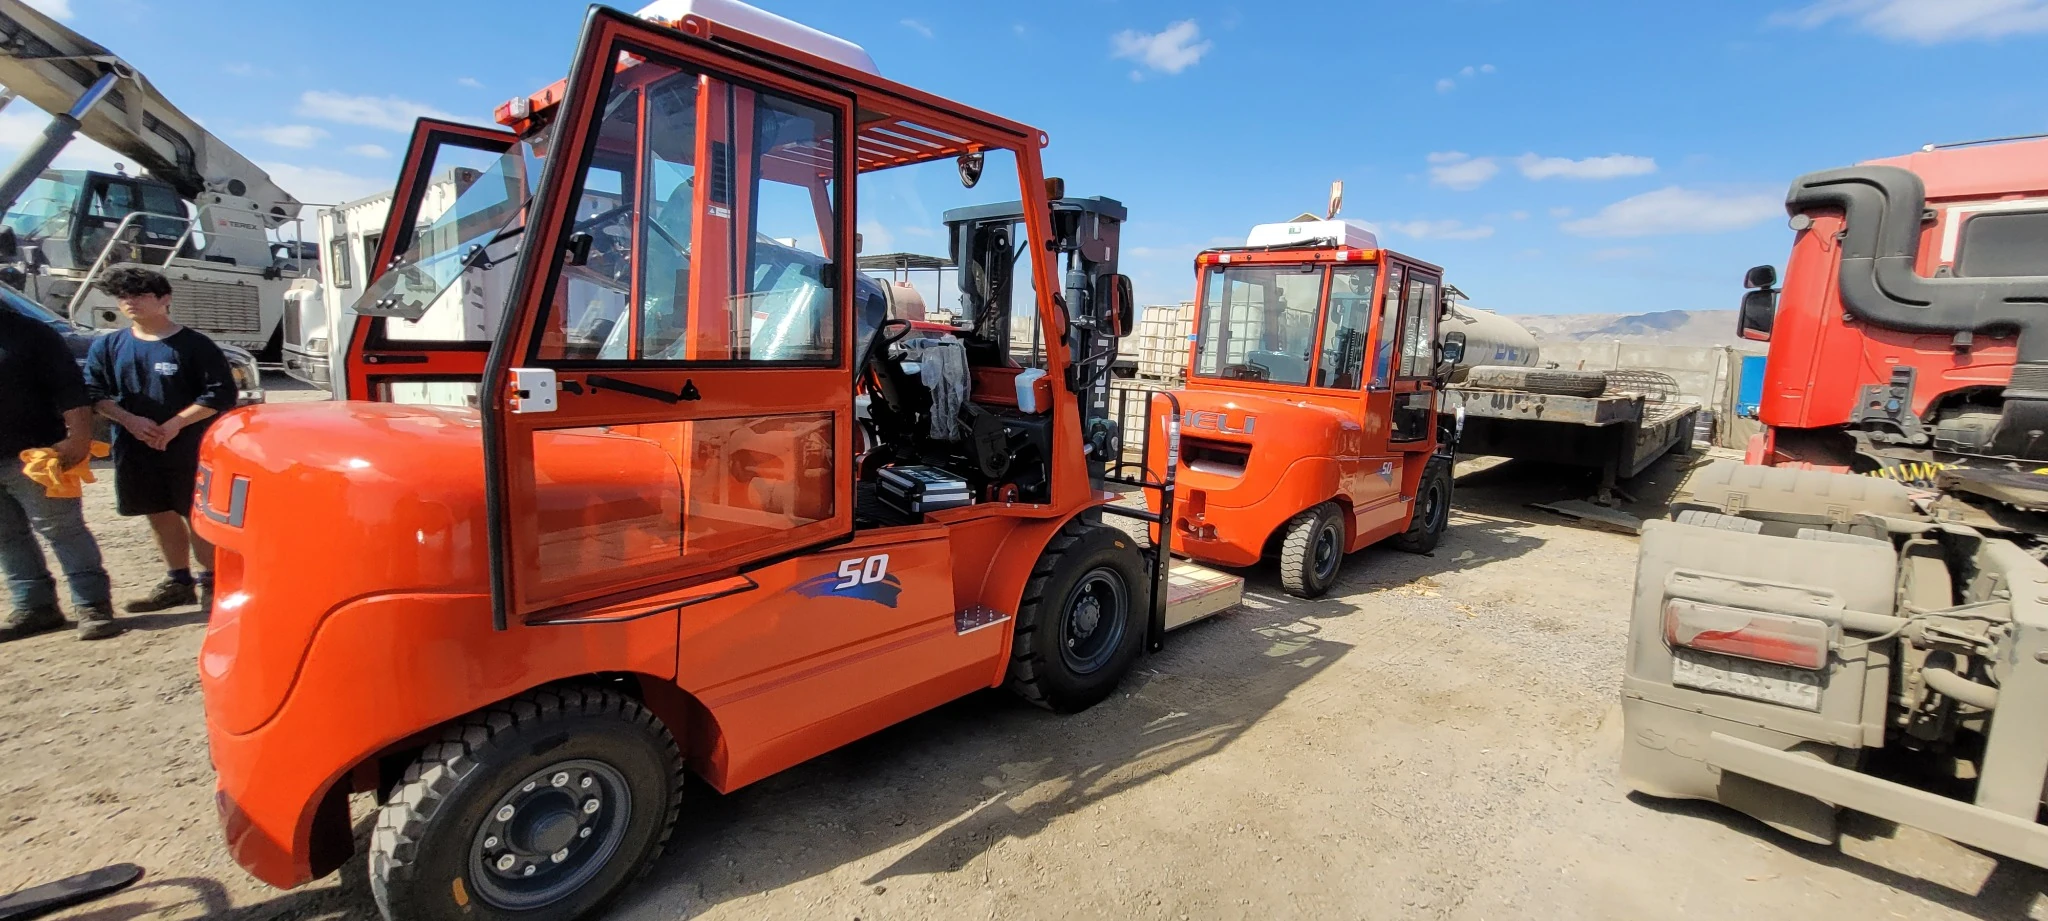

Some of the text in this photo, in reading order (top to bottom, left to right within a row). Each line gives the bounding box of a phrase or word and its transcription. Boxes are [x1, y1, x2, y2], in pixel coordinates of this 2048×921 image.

[228, 220, 258, 230] TEREX
[1093, 338, 1109, 409] HELI
[1381, 461, 1393, 475] 50
[834, 553, 889, 590] 50
